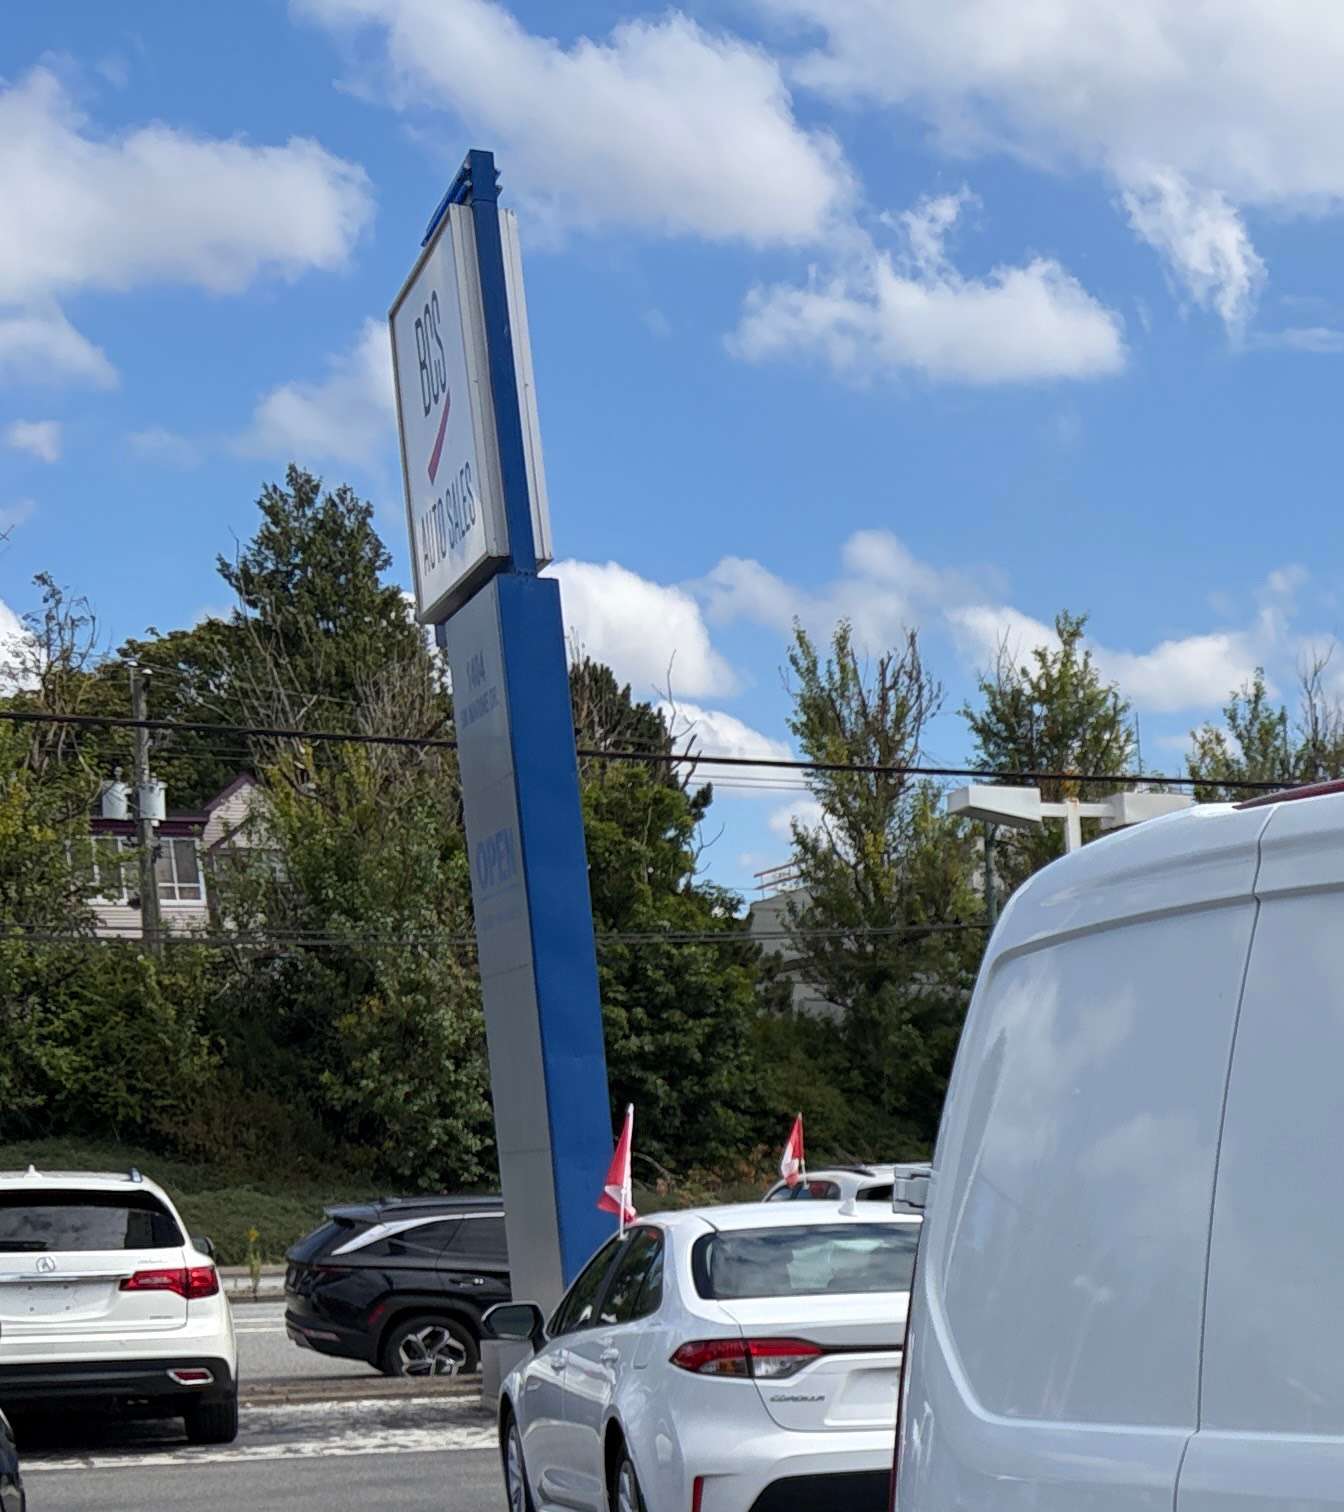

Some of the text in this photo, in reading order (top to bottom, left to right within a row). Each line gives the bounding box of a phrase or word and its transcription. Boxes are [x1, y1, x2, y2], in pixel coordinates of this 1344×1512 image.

[415, 290, 447, 417] BCS
[421, 461, 476, 577] AUTO SALES
